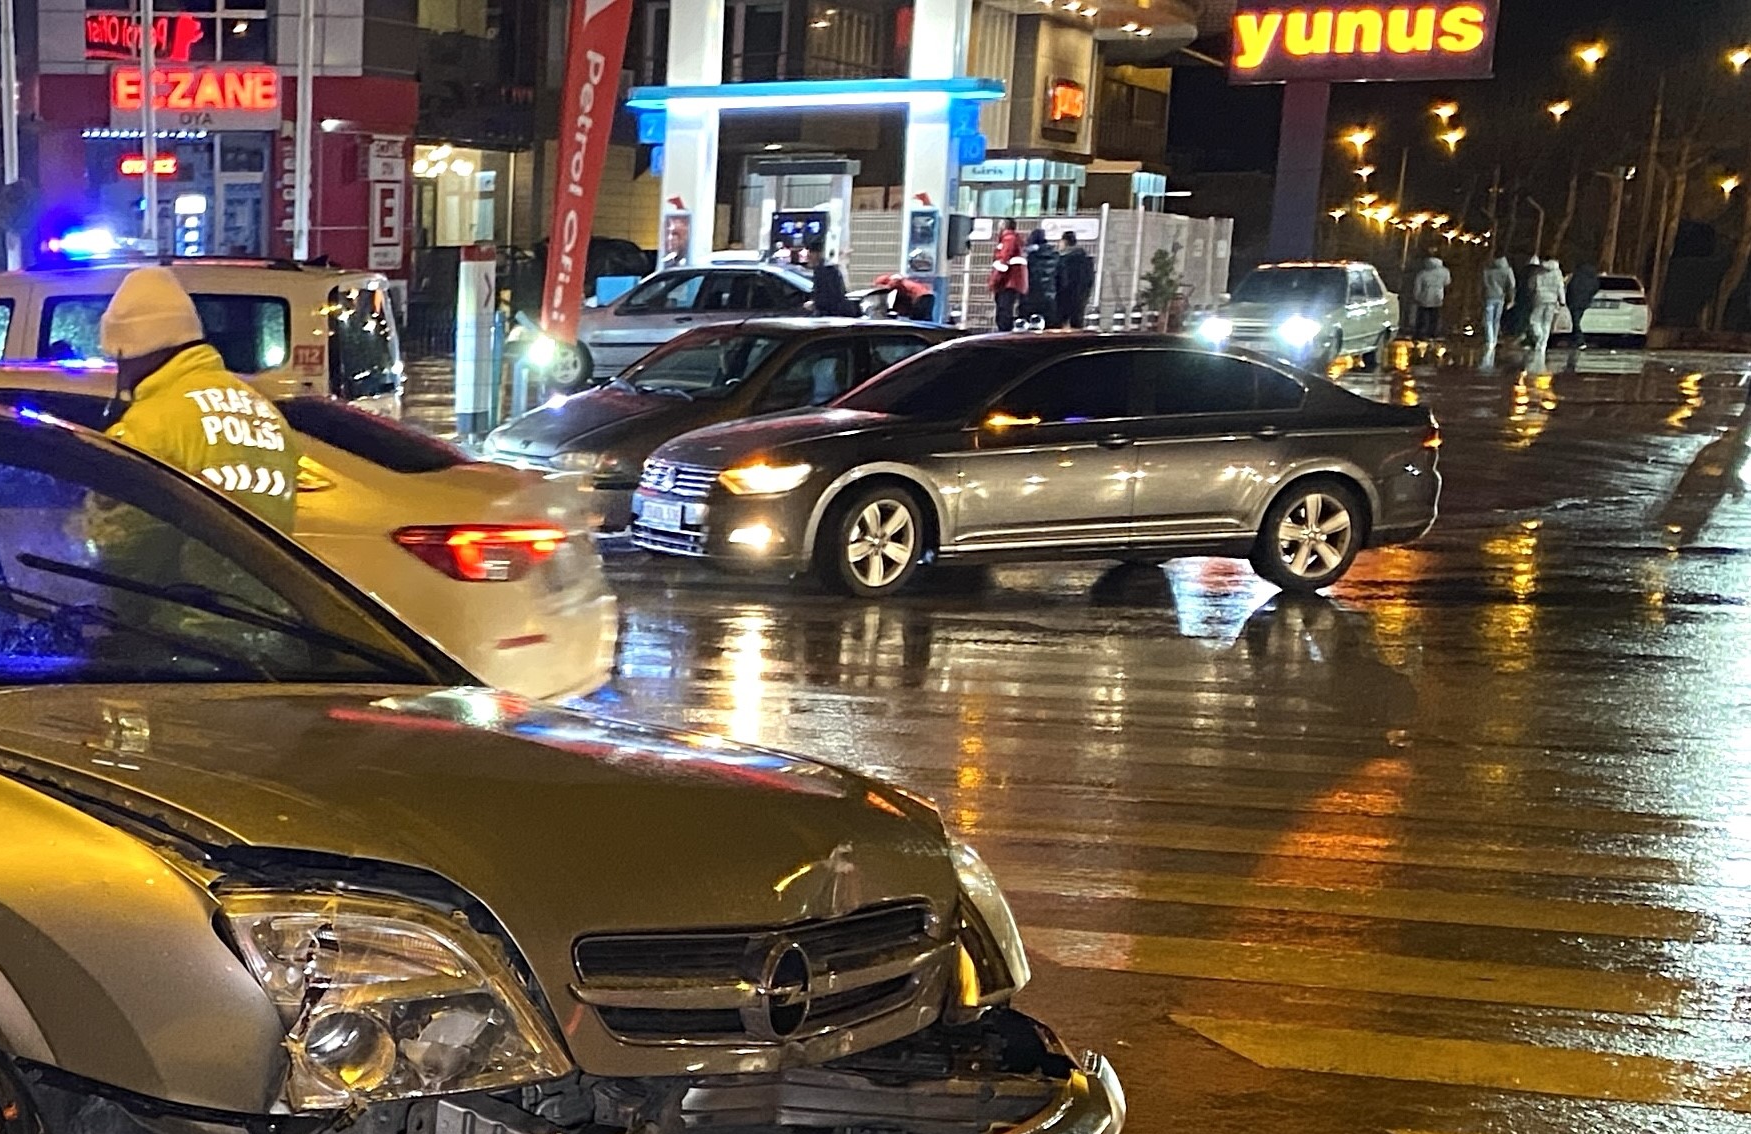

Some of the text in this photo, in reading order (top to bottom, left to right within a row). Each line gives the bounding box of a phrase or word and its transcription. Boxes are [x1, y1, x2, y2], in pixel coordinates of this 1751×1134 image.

[1235, 6, 1485, 69] yunus
[114, 70, 279, 110] ECZANE
[179, 112, 214, 126] OYA
[568, 49, 606, 197] Petrol
[380, 188, 395, 238] E
